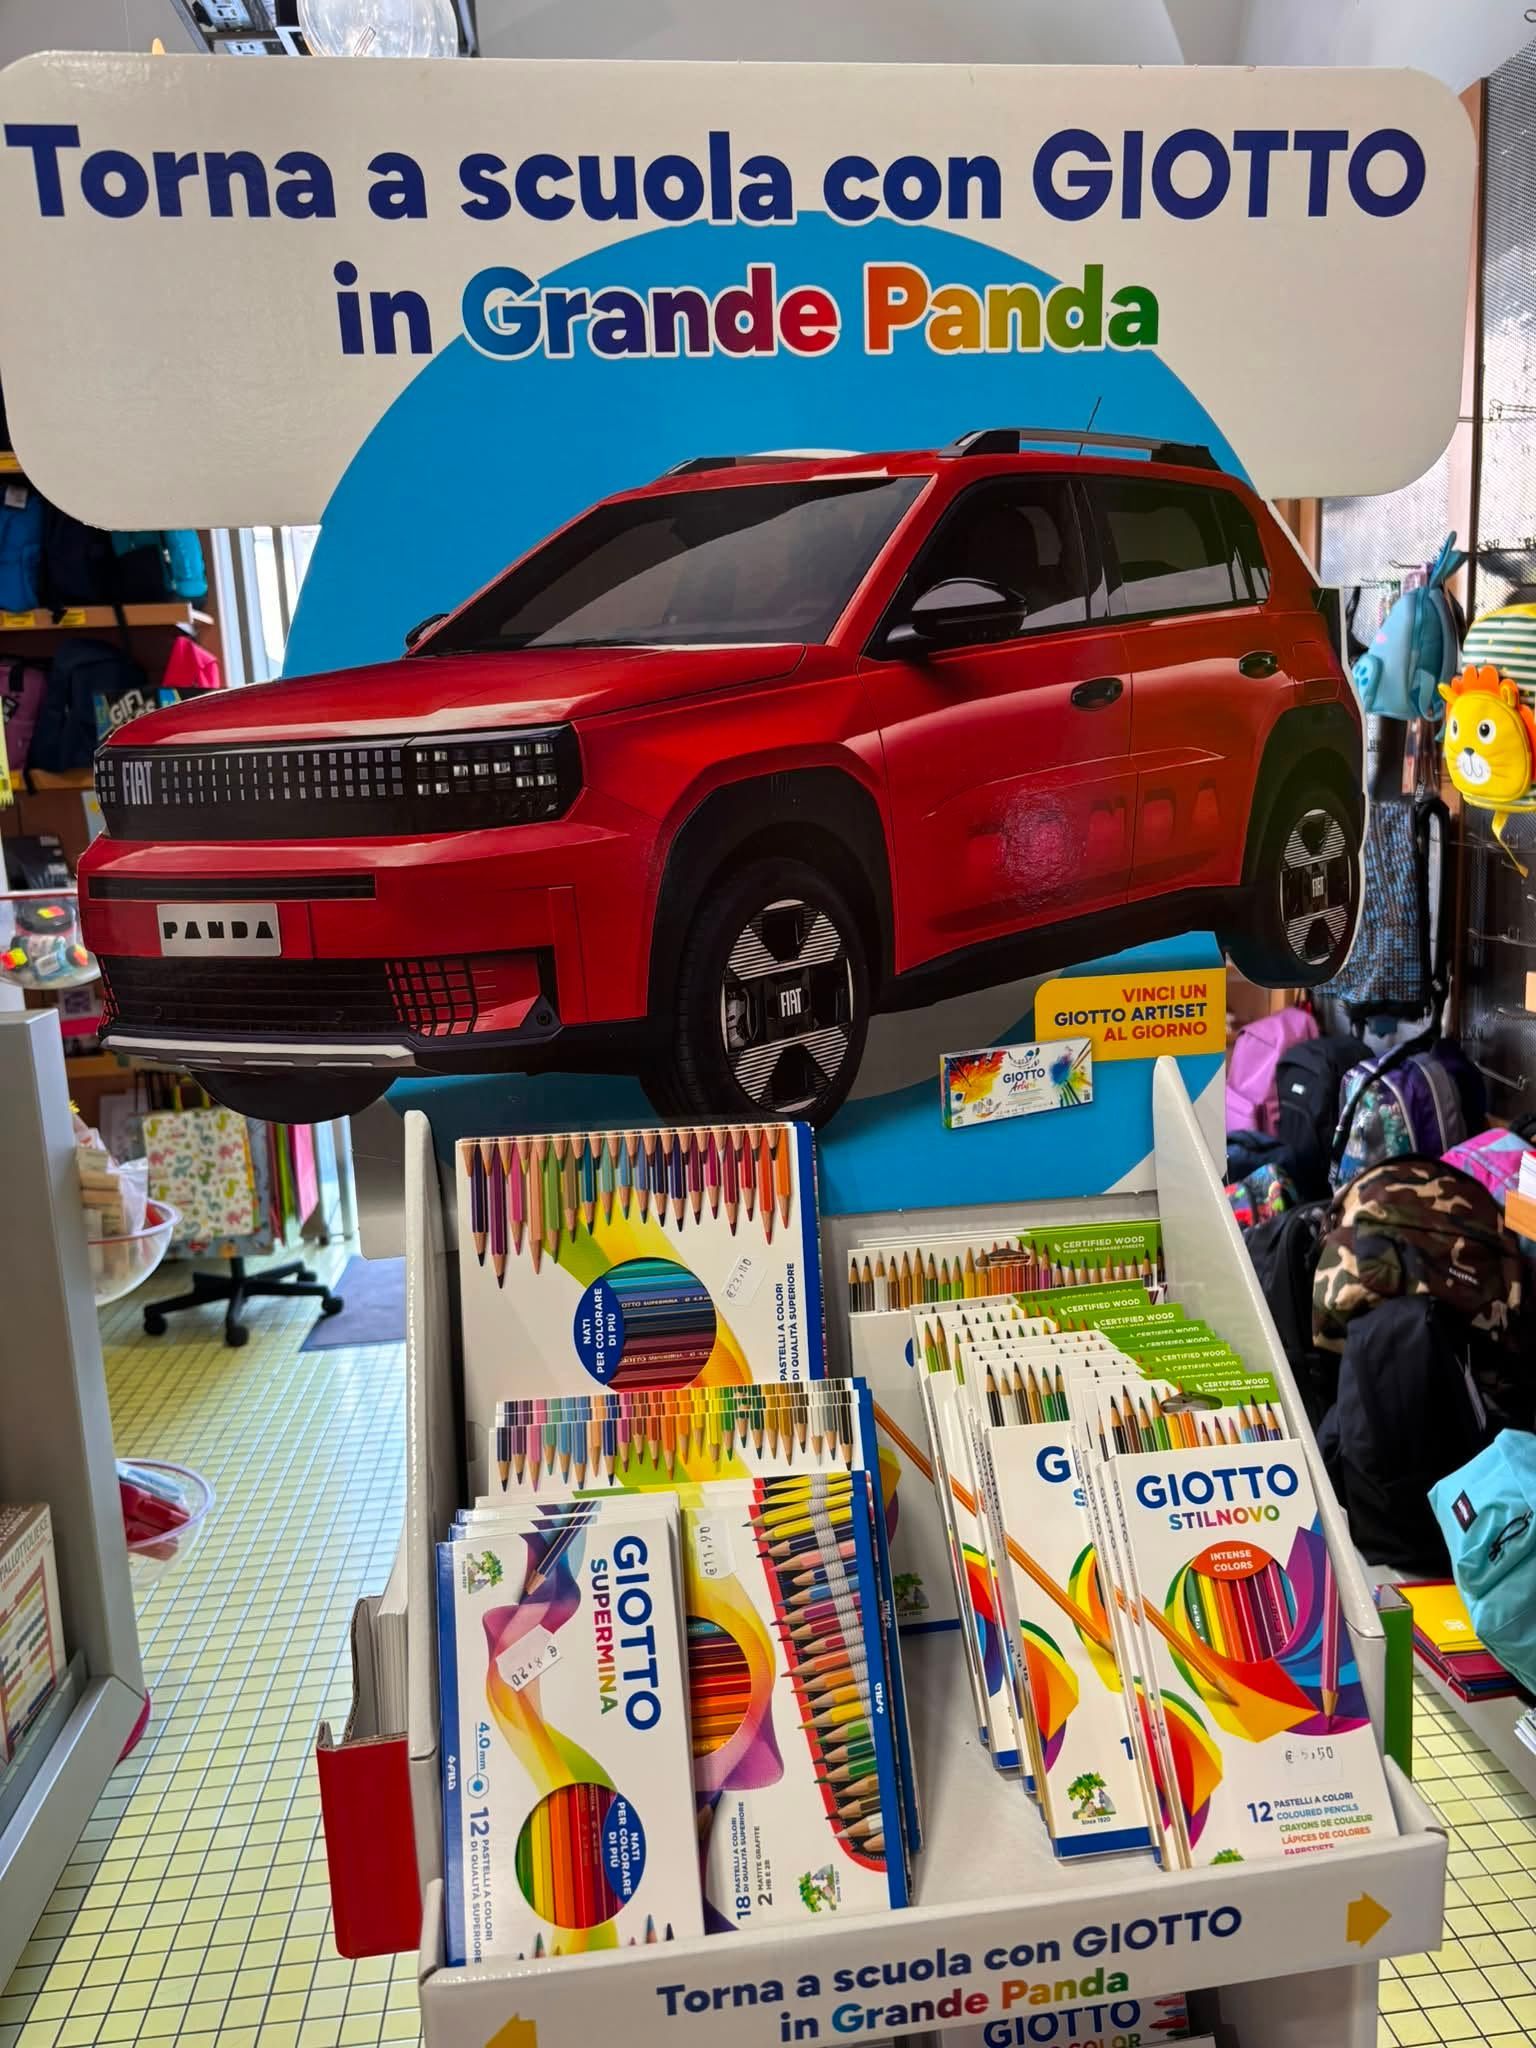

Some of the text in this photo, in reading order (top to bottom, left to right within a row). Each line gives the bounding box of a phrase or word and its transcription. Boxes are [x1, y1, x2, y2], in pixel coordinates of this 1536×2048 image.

[4, 123, 1426, 223] Torna a scuola con GIOTTO
[333, 260, 1160, 360] in Grande Panda
[122, 761, 153, 805] FIAT
[163, 921, 274, 939] PANDA
[780, 988, 802, 1017] FIAT
[1122, 983, 1207, 1003] VINCI UN
[1054, 1002, 1208, 1027] GIOTTO ARTISET
[1103, 1021, 1208, 1042] AL GIORNO
[1003, 1068, 1046, 1084] GIOTTO
[1062, 1235, 1145, 1249] CERTIFIED WOOD
[1066, 1298, 1140, 1313] CERTIFIED WOOD
[1100, 1315, 1144, 1327] CERTIFIED
[1146, 1312, 1175, 1322] WOOD
[583, 1318, 592, 1344] NATI
[594, 1288, 605, 1374] PER COLORARE
[607, 1313, 617, 1346] DI PIÙ
[775, 1283, 787, 1381] PASTELLI A COLORI
[786, 1263, 800, 1381] DI QUALITÀ SUPERIORE
[1162, 1349, 1226, 1362] CERTIFIED WOOD
[1202, 1377, 1269, 1389] CERTIFIED WOOD
[1136, 1463, 1299, 1509] GIOTTO
[1168, 1504, 1280, 1531] STILNOVO
[699, 1526, 718, 1576] €11,90
[1210, 1549, 1252, 1561] INTENSE
[1213, 1561, 1254, 1572] COLORS
[590, 1558, 618, 1715] SUPERMINA
[613, 1535, 662, 1731] GIOTTO
[478, 1722, 490, 1770] 4.0 mm
[1285, 1750, 1294, 1763] €
[1247, 1801, 1273, 1823] 12
[1274, 1792, 1353, 1808] PASTELLI A COLORI
[1276, 1803, 1359, 1821] COLOURED PENCILS
[470, 1807, 490, 1836] 12
[738, 1801, 746, 1845] SUPERIORE
[1279, 1814, 1373, 1832] CRAYONS DE COULEUR
[1281, 1826, 1371, 1845] LÁPICES DE COLORES
[608, 1831, 620, 1868] DI PIÙ
[617, 1802, 632, 1896] PER COLORARE
[630, 1832, 641, 1861] NATI
[733, 1855, 741, 1893] PASTELLI
[743, 1884, 749, 1892] DI
[471, 1841, 482, 1964] DI QUALITÀ SUPERIORE
[482, 1839, 493, 1941] PASTELLI A COLORI
[758, 1893, 773, 1906] 2
[735, 1895, 752, 1920] 18
[656, 1905, 1243, 2018] Torna a scuola con GIOTTO
[780, 1966, 1129, 2043] in Grande Panda
[984, 2000, 1141, 2048] GIOTTO
